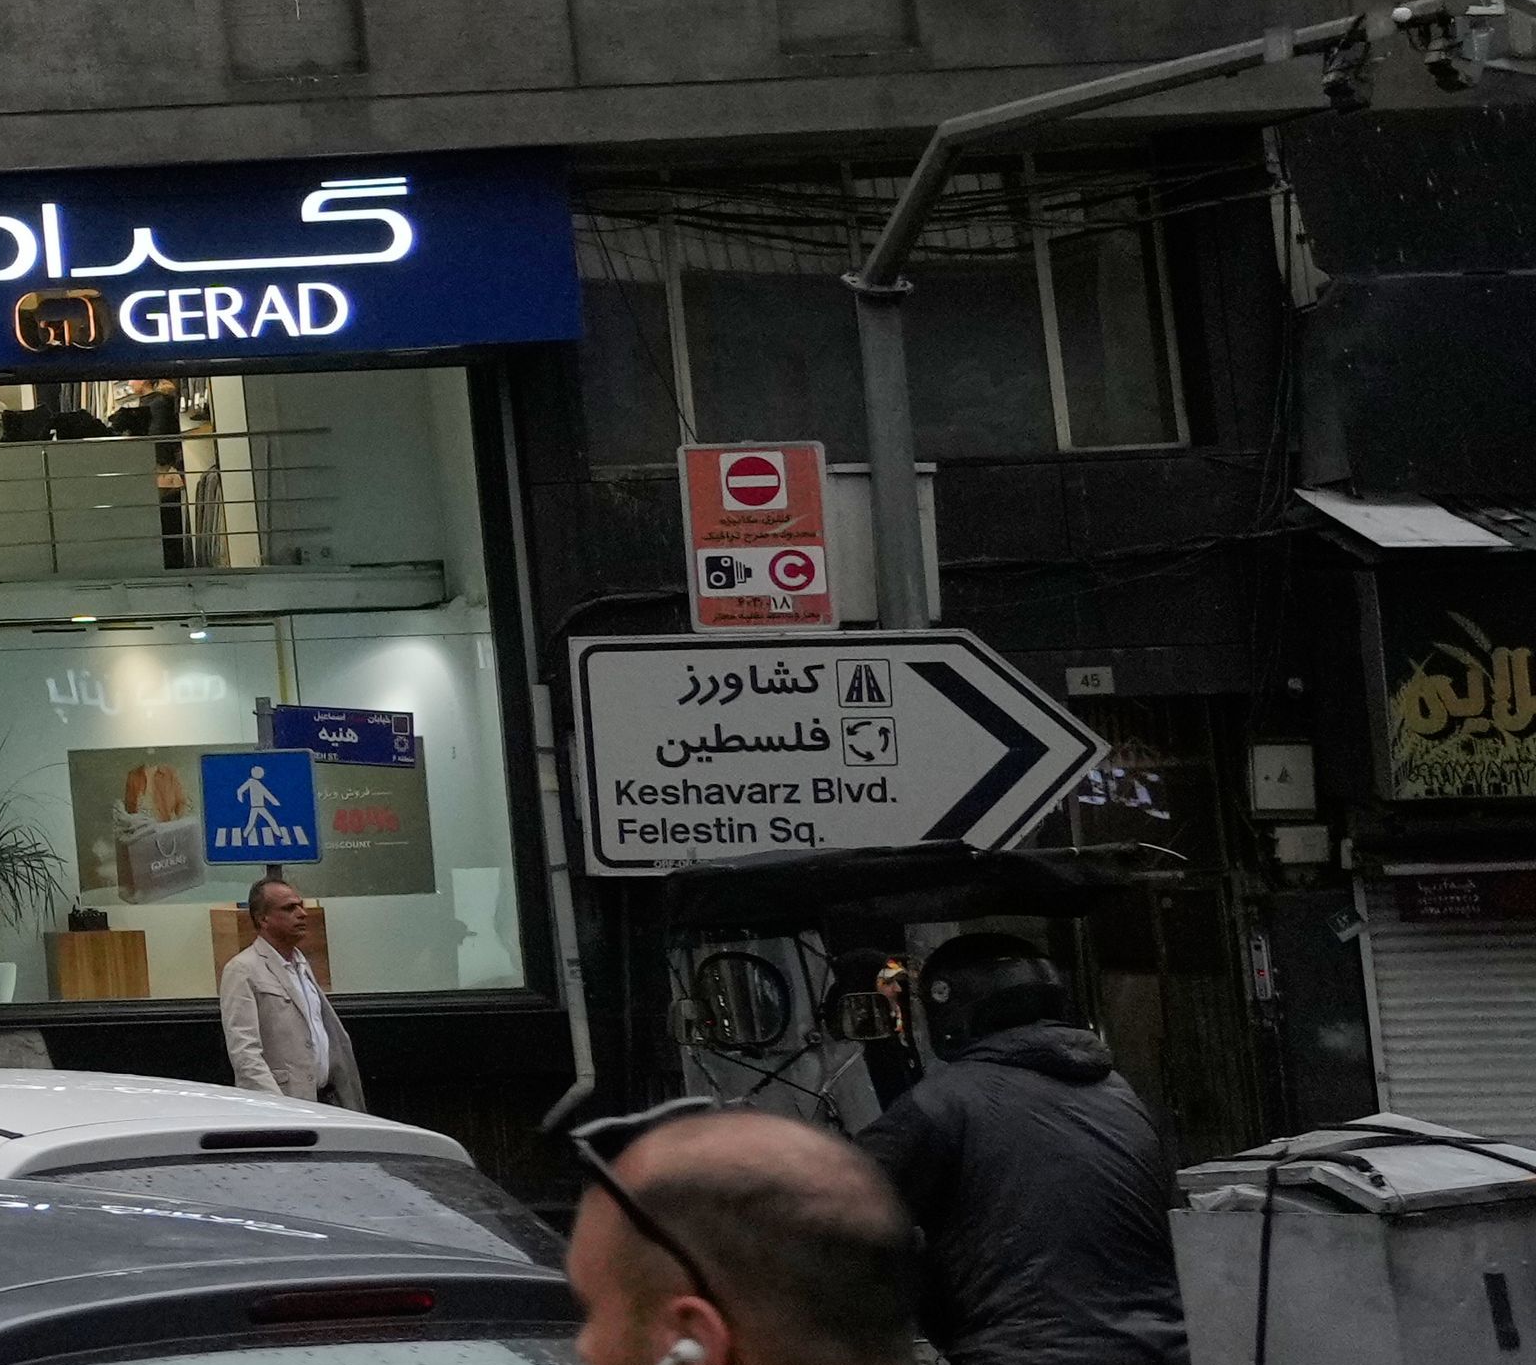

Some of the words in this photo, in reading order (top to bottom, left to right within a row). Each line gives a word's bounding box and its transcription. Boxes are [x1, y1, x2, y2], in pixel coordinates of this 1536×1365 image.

[119, 282, 349, 344] GERAD
[676, 662, 825, 706] کشاورز
[1080, 674, 1100, 688] 45
[318, 726, 359, 747] هنیه
[655, 717, 830, 769] فلسطین
[614, 779, 802, 806] Keshavarz
[812, 778, 898, 805] Blvd.
[617, 817, 758, 845] Felestin
[768, 815, 825, 848] Sq.
